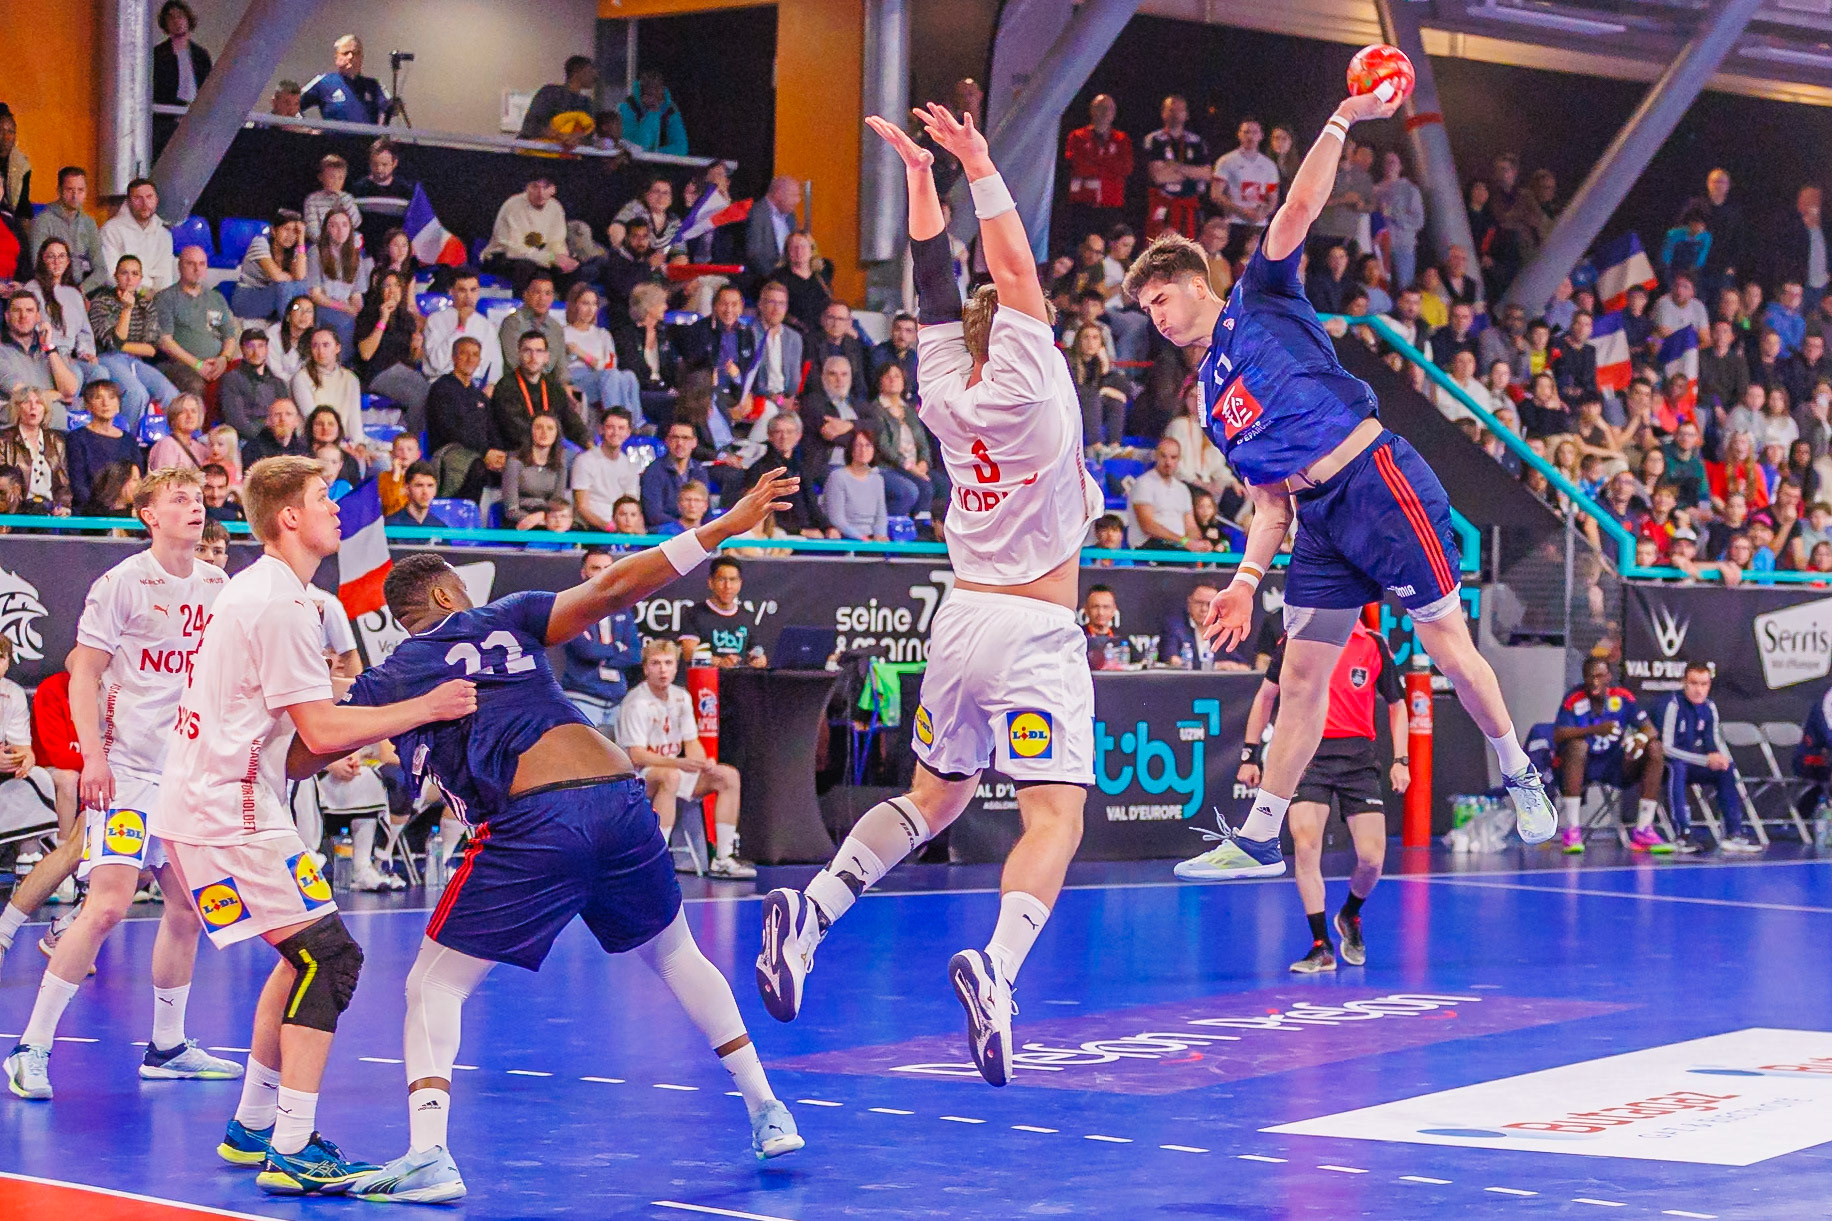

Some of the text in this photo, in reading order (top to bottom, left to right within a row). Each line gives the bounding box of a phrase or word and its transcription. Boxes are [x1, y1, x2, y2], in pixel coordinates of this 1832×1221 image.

[179, 603, 205, 637] 24
[835, 597, 913, 632] seine
[1764, 619, 1829, 654] Serris
[976, 784, 992, 798] AL
[1106, 804, 1183, 821] VAL D'EUROPE
[1502, 1091, 1742, 1133] Butagaz
